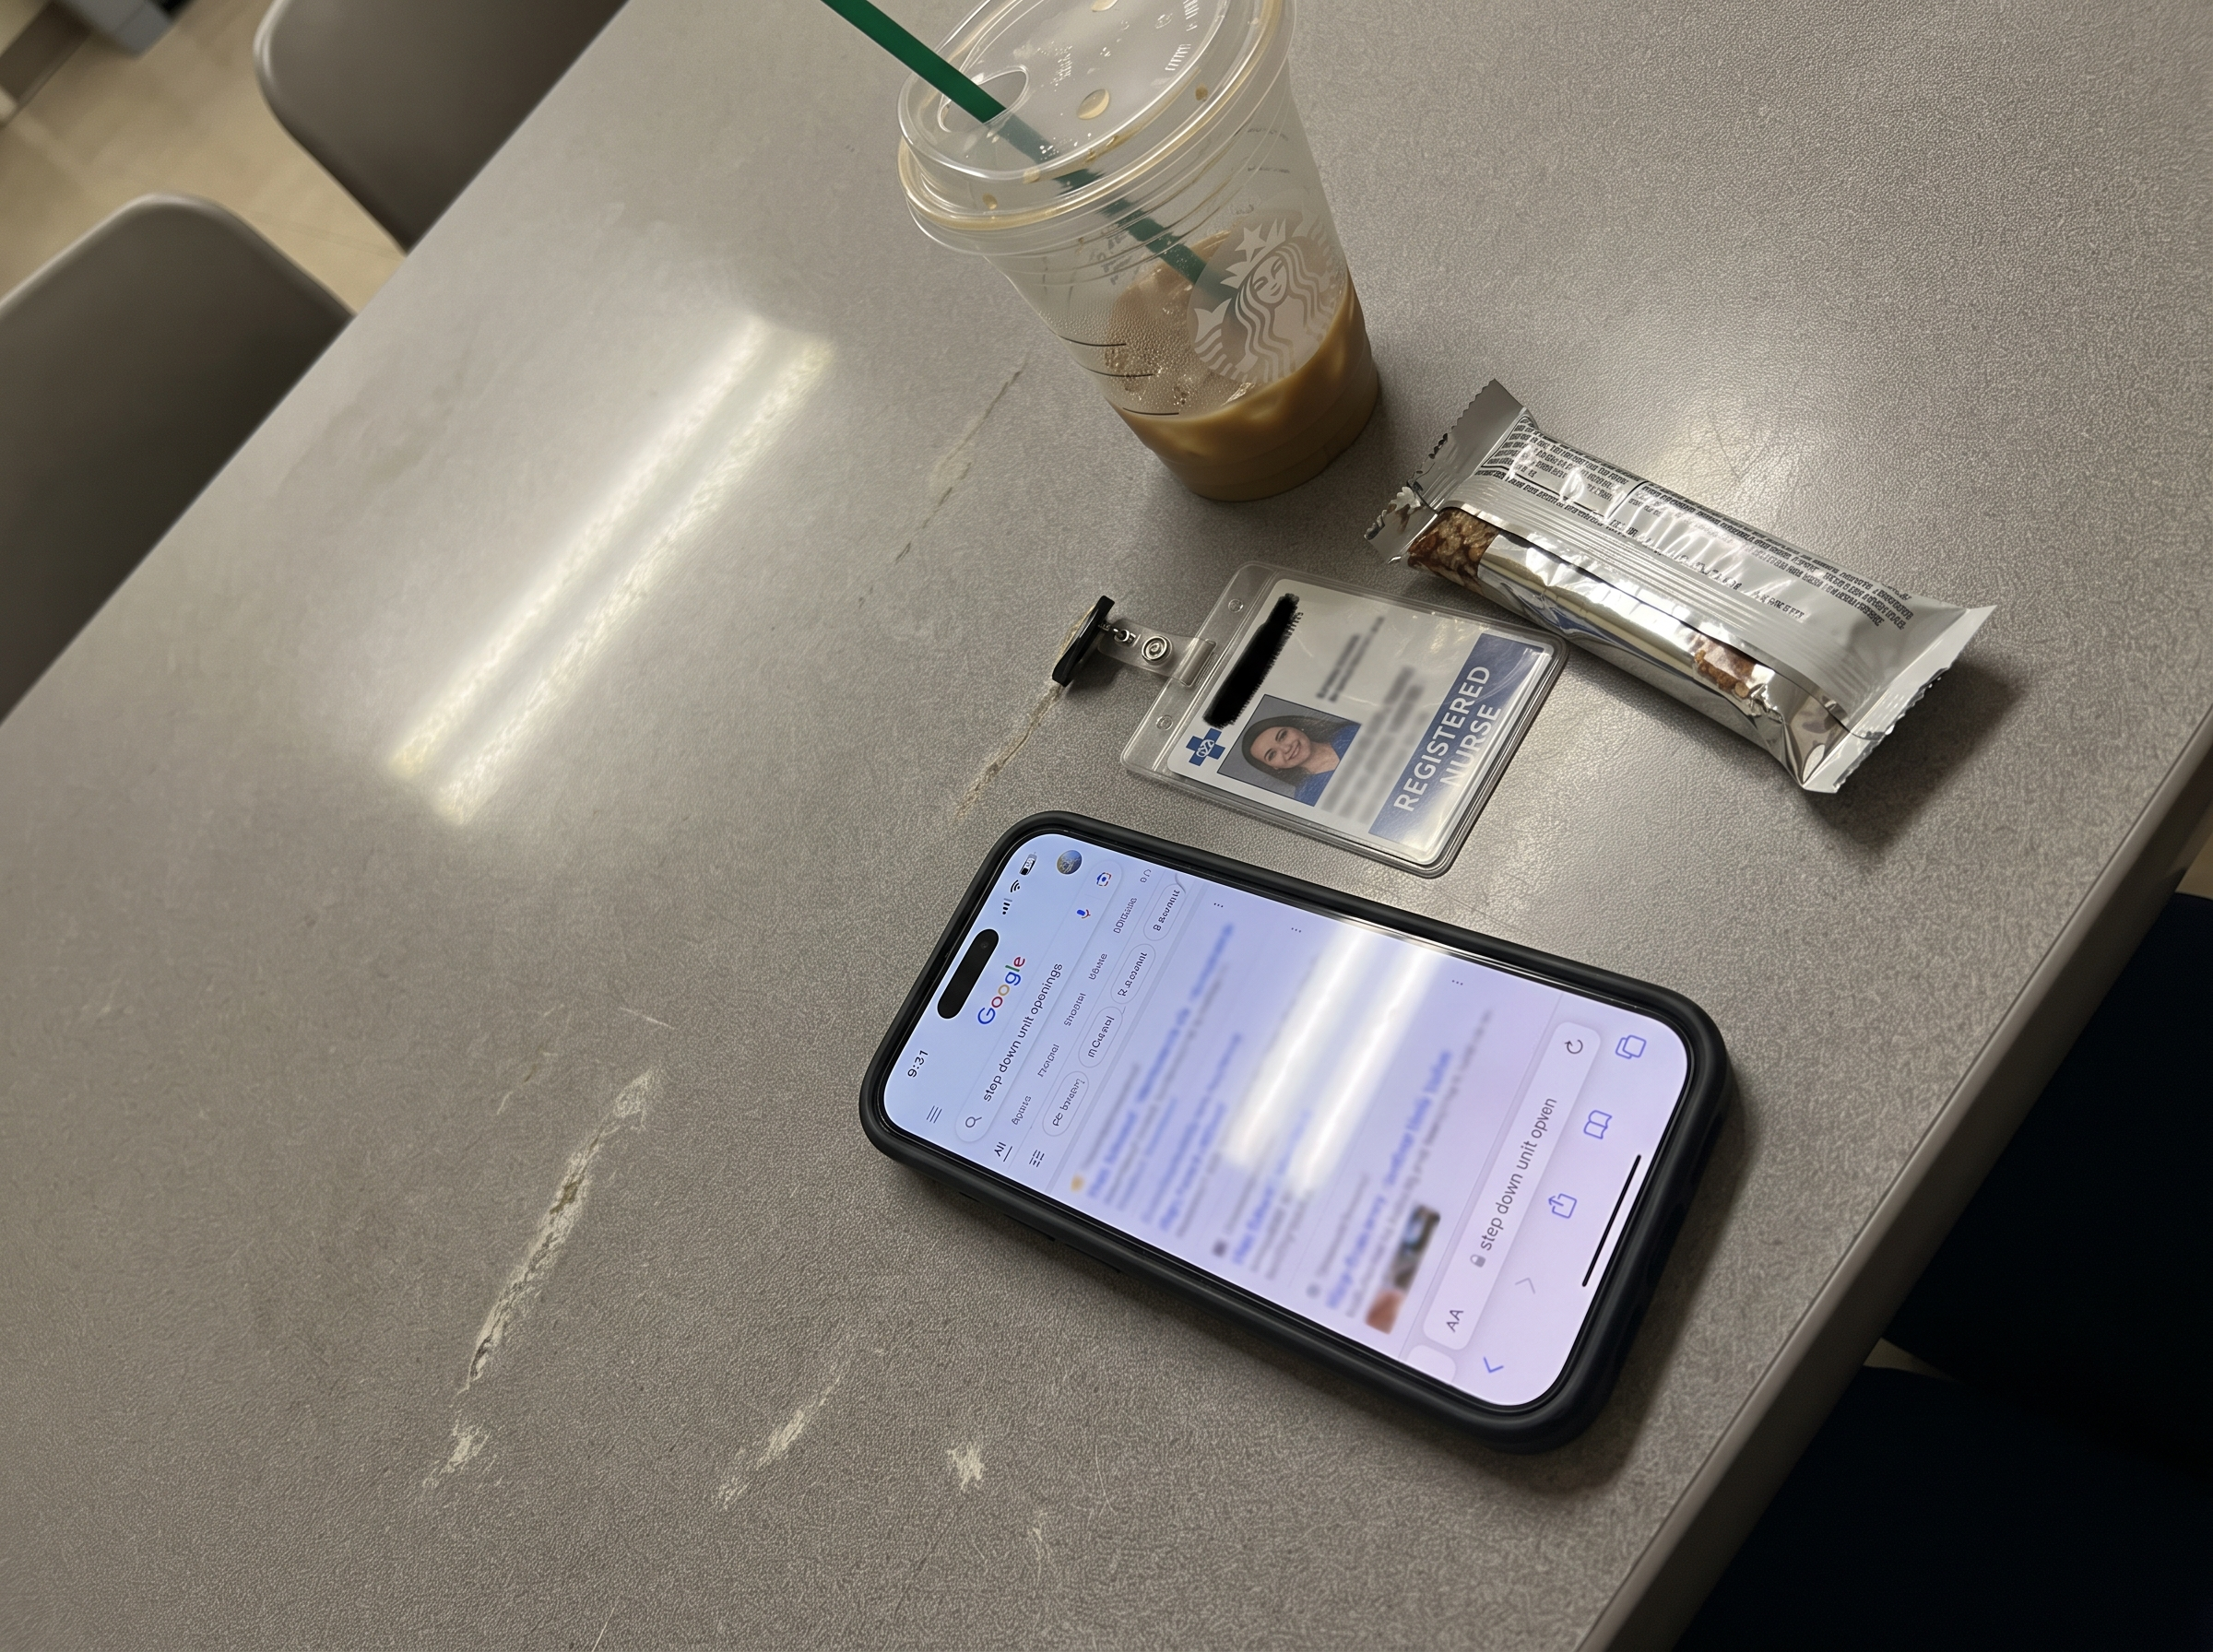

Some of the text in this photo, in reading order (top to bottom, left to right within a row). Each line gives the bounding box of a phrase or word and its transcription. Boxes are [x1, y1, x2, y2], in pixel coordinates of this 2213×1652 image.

[1393, 666, 1491, 812] REGISTERED
[1439, 703, 1502, 788] NURSE
[977, 955, 1026, 1025] Google
[999, 1040, 1022, 1073] down
[1030, 962, 1063, 1015] openings
[906, 1049, 929, 1079] 9:31
[993, 1141, 1007, 1158] All
[1480, 1216, 1504, 1251] step
[1497, 1173, 1523, 1215] down
[1516, 1139, 1538, 1170] unit
[1446, 1308, 1464, 1333] AA
